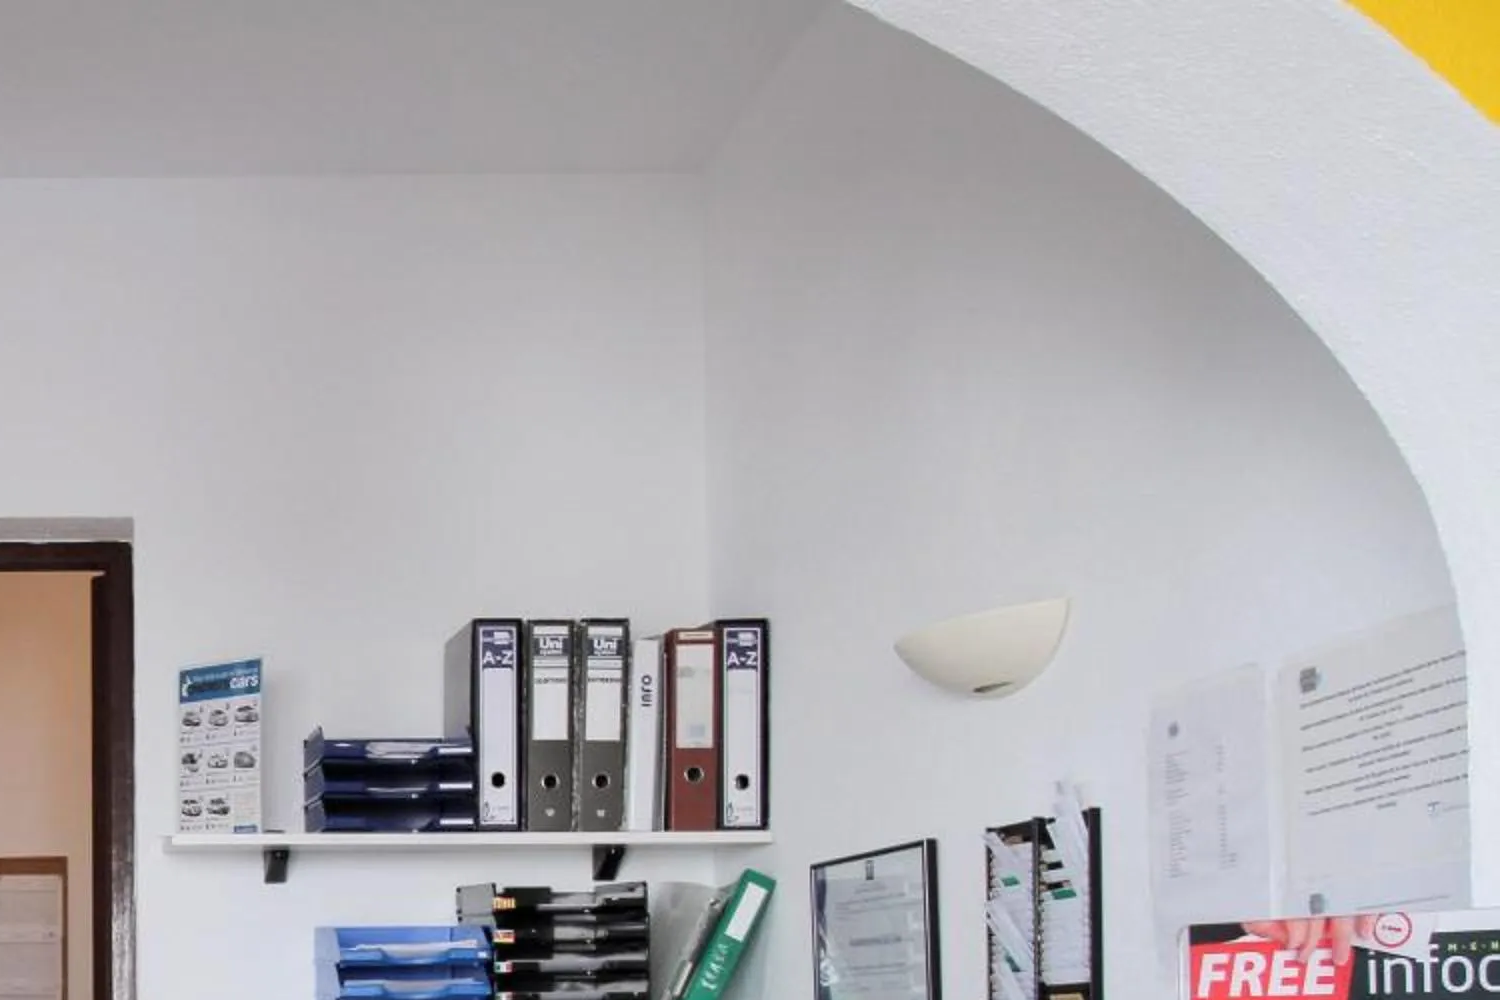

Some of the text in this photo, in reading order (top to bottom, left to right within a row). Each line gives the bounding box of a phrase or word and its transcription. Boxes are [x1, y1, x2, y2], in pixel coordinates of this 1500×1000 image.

[539, 637, 563, 650] Uni
[593, 637, 617, 650] Uni
[483, 650, 513, 665] A-Z
[727, 651, 758, 666] A-Z
[229, 674, 259, 689] cars
[1196, 946, 1337, 999] FREE
